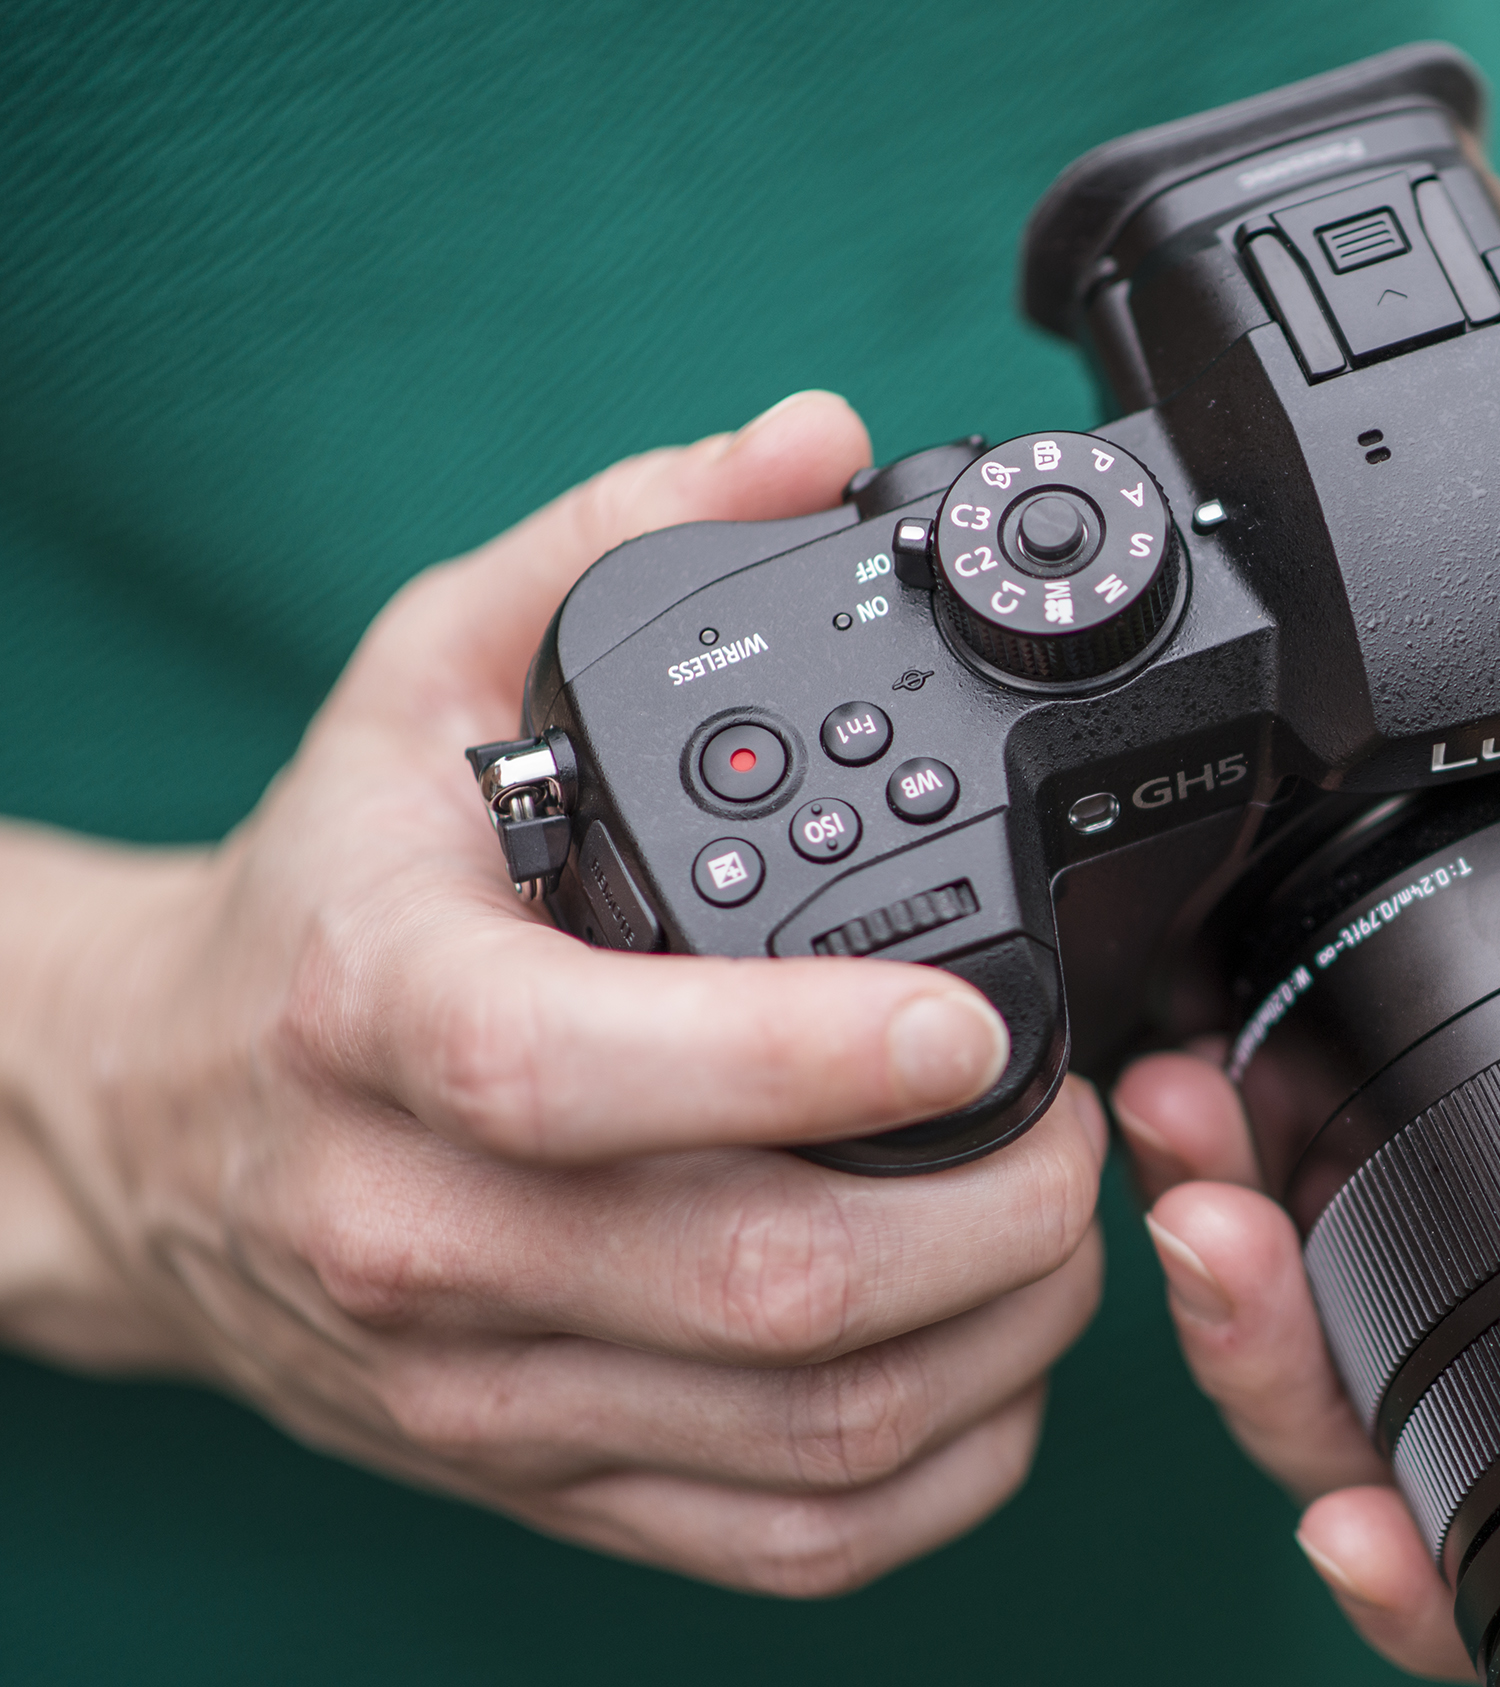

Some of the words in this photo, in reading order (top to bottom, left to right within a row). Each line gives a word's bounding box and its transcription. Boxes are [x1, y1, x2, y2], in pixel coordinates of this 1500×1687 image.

[1090, 447, 1115, 473] P
[1120, 482, 1146, 509] A
[950, 502, 993, 532] C3
[1128, 532, 1154, 558] S
[854, 552, 892, 585] OFF
[954, 545, 999, 578] C2
[991, 580, 1027, 615] C1
[1094, 573, 1129, 605] M
[856, 595, 890, 625] ON
[667, 631, 769, 687] WIRELESS
[835, 713, 877, 744] Fn1
[900, 769, 944, 799] WB
[1132, 753, 1249, 812] GH5
[804, 812, 845, 843] ISO
